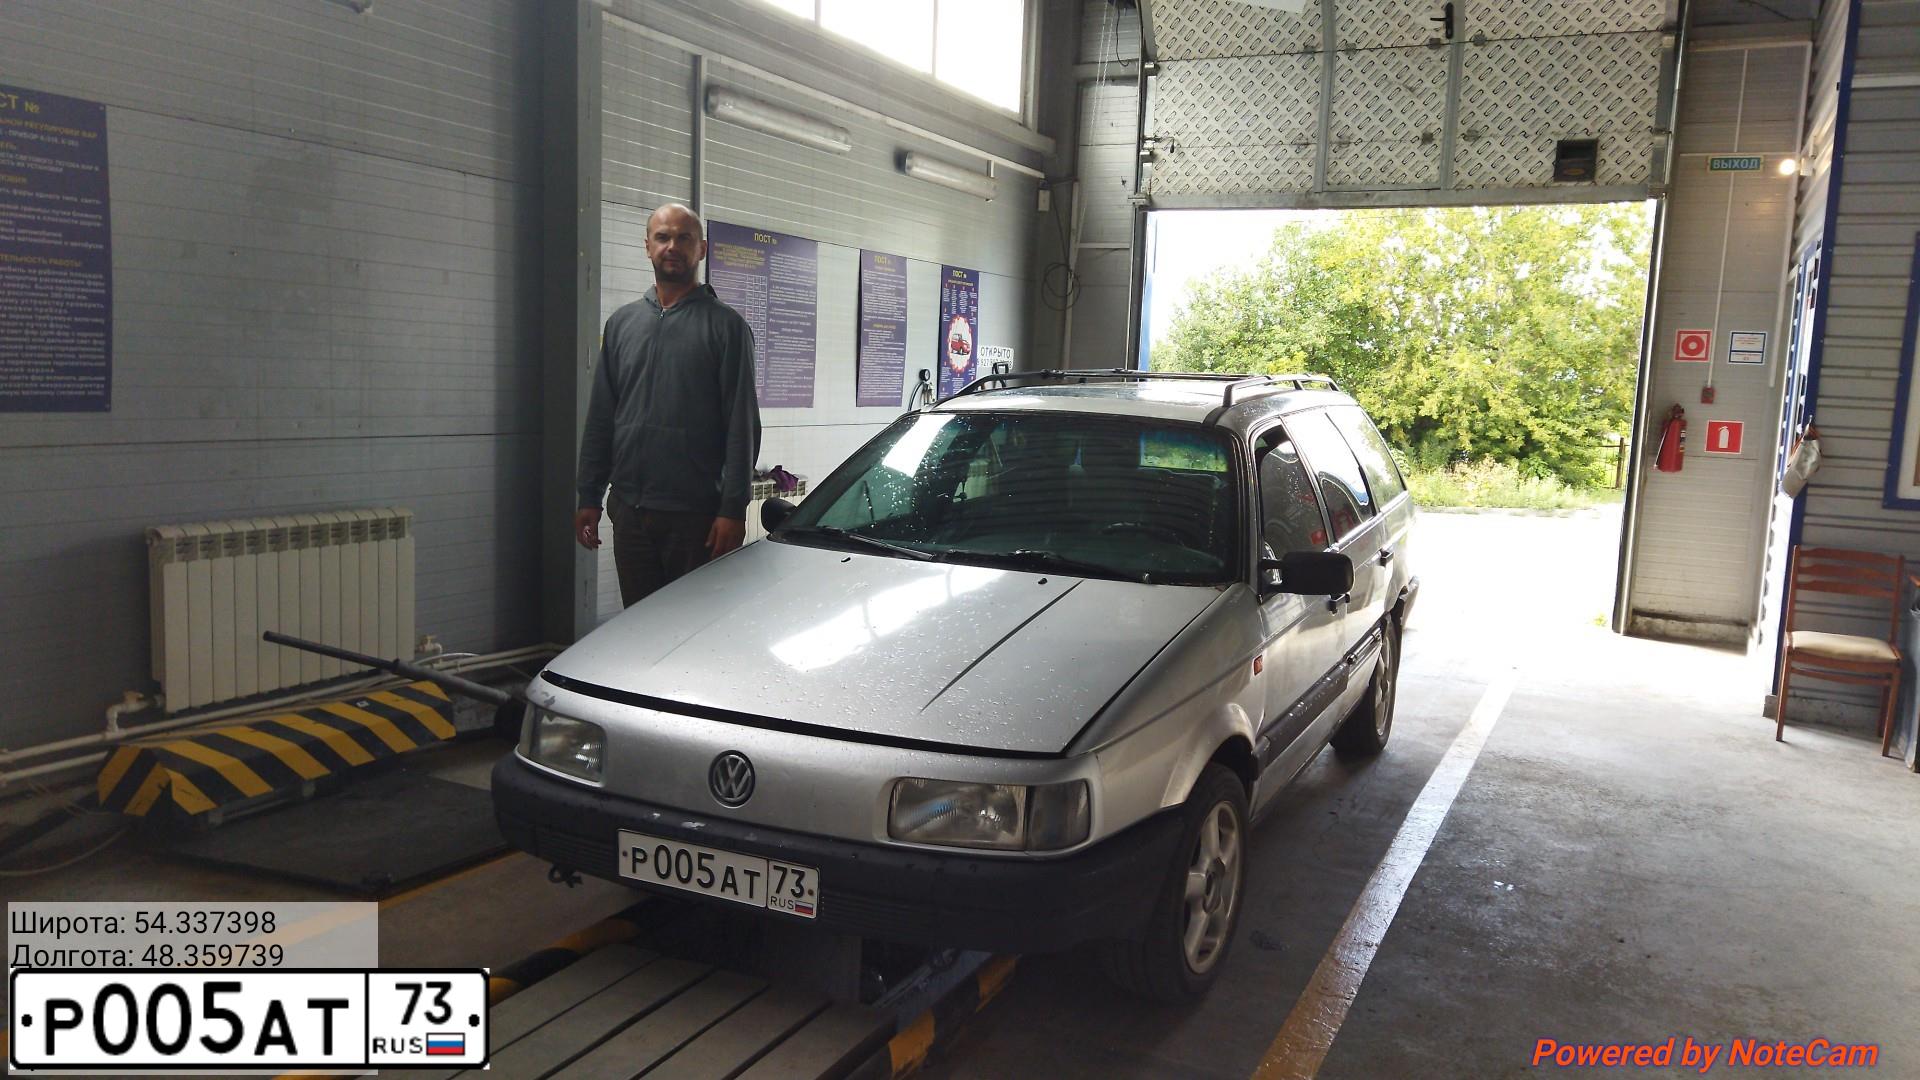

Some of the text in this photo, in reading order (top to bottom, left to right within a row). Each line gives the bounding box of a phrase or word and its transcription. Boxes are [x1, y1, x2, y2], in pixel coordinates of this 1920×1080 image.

[1712, 158, 1759, 170] ВЫХОД
[753, 232, 772, 244] ПОСТ
[980, 346, 1011, 359] ОТКРЫТО
[631, 844, 806, 899] Р005АТ 73
[770, 896, 795, 910] RUS
